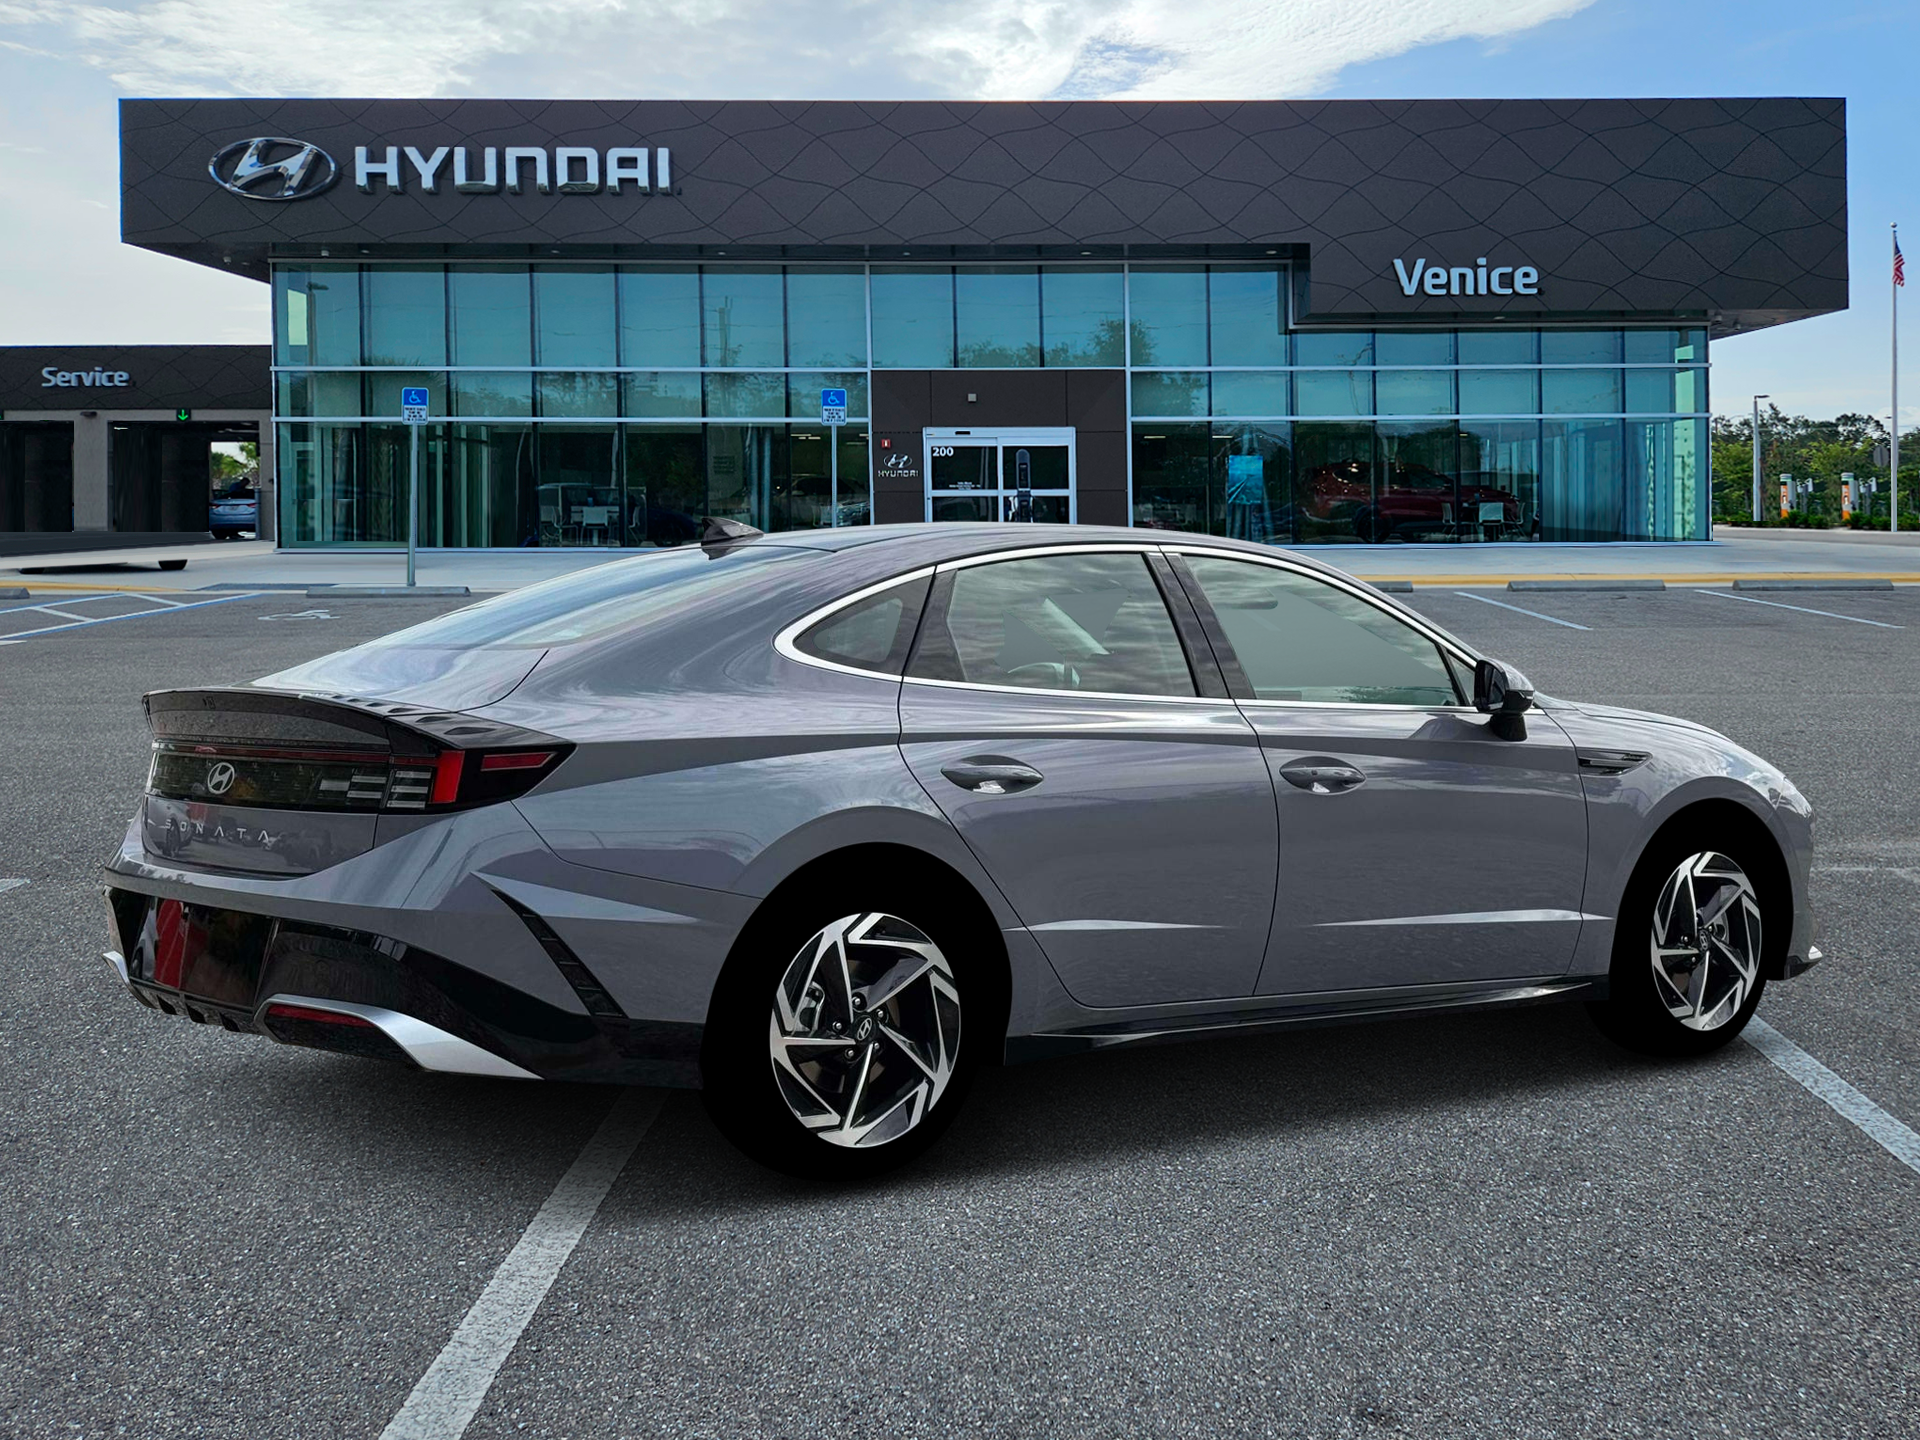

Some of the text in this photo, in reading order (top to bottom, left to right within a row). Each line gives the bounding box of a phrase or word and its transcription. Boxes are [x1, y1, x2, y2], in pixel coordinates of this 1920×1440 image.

[355, 146, 671, 194] HYUNDAI
[1393, 257, 1539, 295] Venice
[41, 366, 130, 387] Service
[932, 447, 954, 457] 200
[878, 470, 919, 478] HYUNDAI
[165, 819, 269, 843] SONATA
